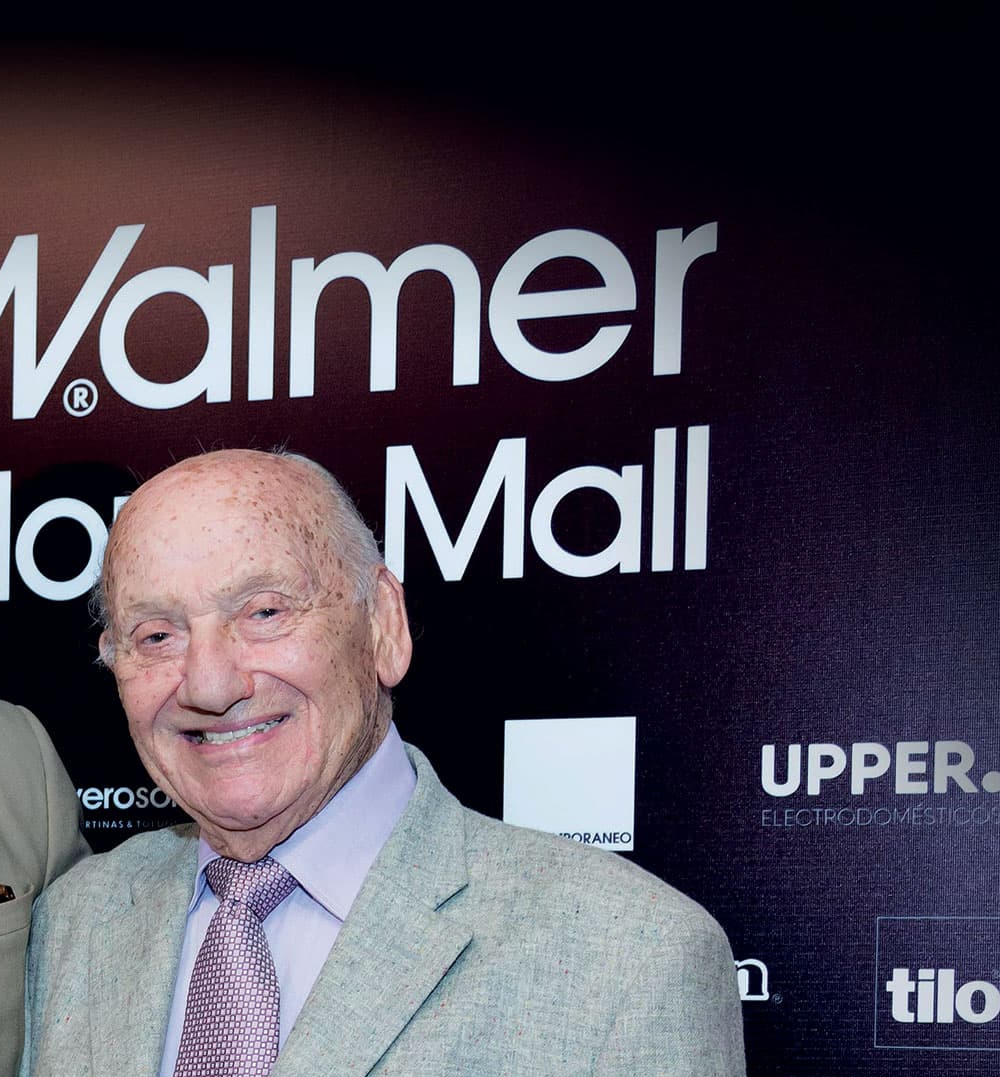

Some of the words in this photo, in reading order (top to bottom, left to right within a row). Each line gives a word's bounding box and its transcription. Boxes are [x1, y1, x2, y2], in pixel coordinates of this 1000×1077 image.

[385, 424, 710, 583] Mall
[761, 740, 1000, 797] UPPER.
[81, 819, 124, 829] RTINAS
[559, 831, 632, 844] ORANEO
[886, 967, 1000, 1024] tilo
